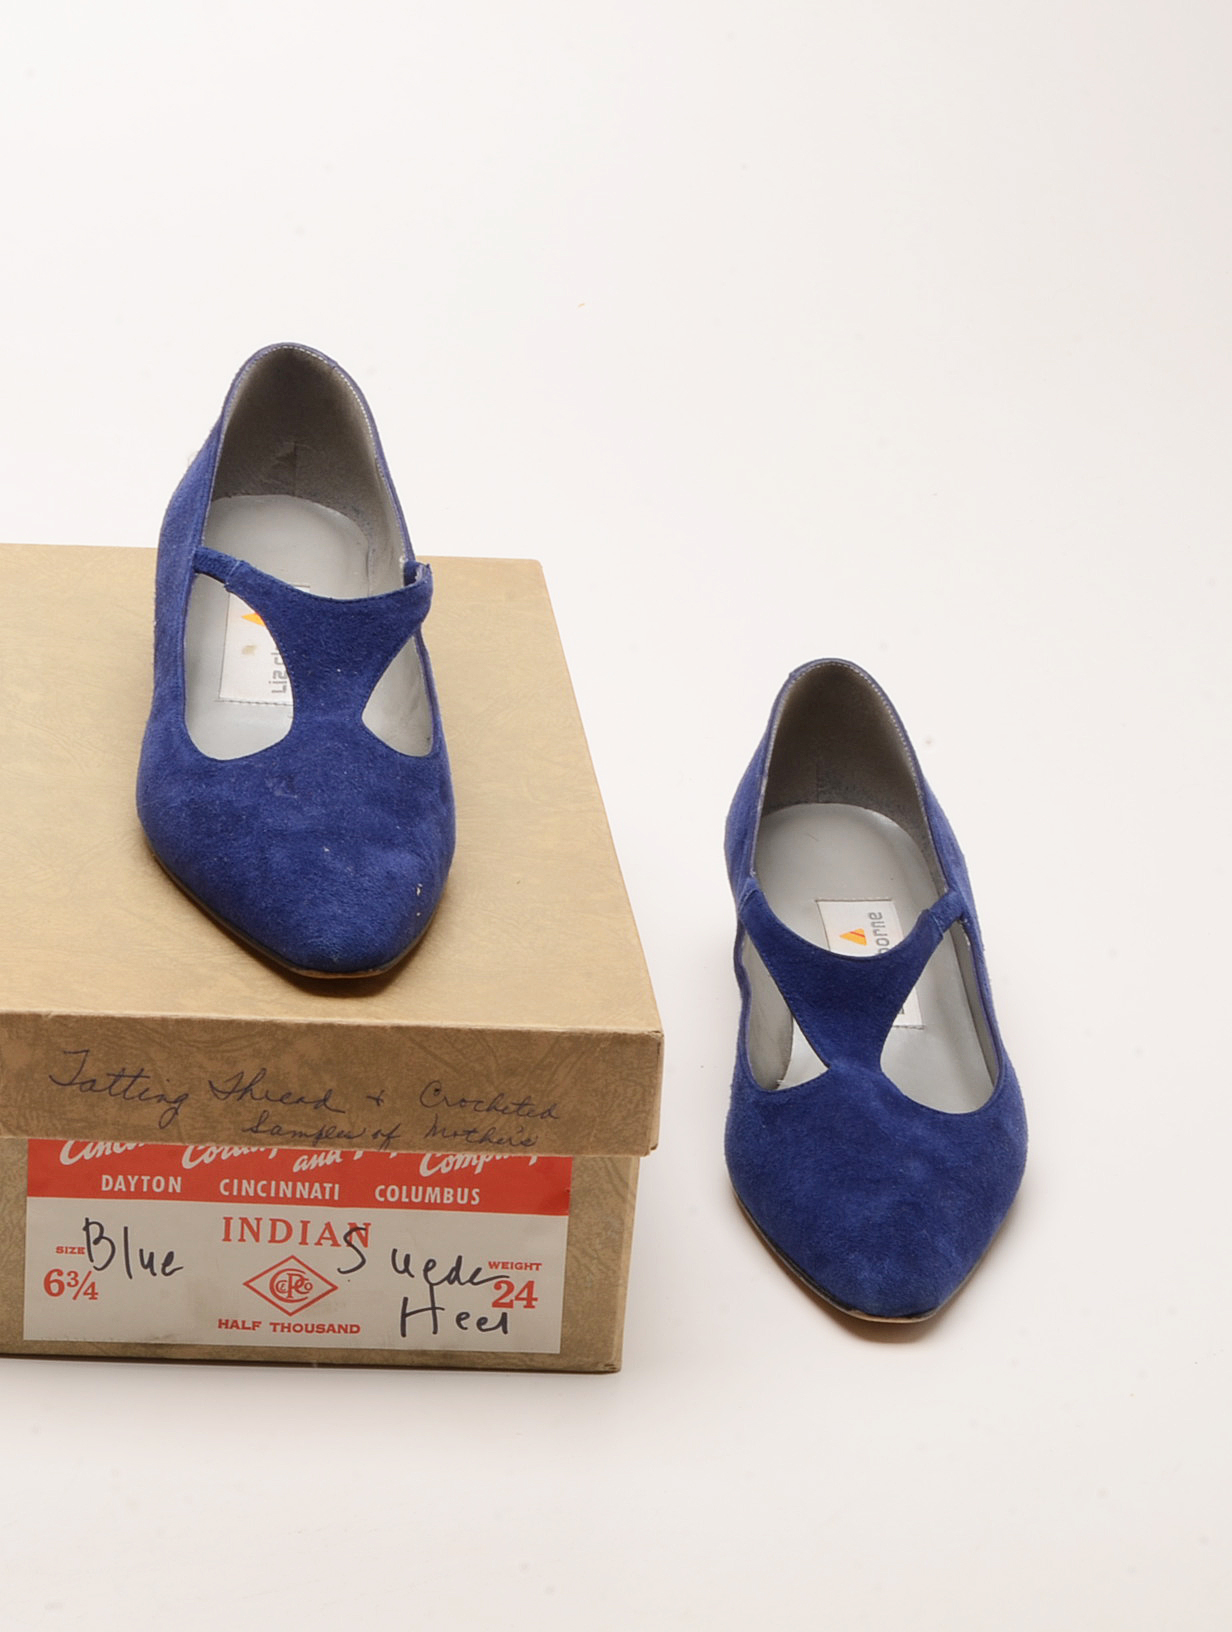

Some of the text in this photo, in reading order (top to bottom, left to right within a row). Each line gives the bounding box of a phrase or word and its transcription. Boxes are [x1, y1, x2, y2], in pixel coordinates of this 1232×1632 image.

[49, 1049, 189, 1130] Tatting
[207, 1067, 345, 1114] Thread
[419, 1080, 560, 1121] Crocheted
[370, 1122, 403, 1151] of
[101, 1174, 481, 1206] DAYTON CINCINNATI COLUMBUS
[221, 1216, 372, 1249] INDIAN
[55, 1245, 86, 1255] SIZE
[82, 1217, 184, 1280] Blue
[487, 1260, 543, 1272] WEIGHT
[491, 1279, 539, 1310] 24
[217, 1318, 361, 1335] HALF THOUSAND
[400, 1284, 509, 1338] Heel
